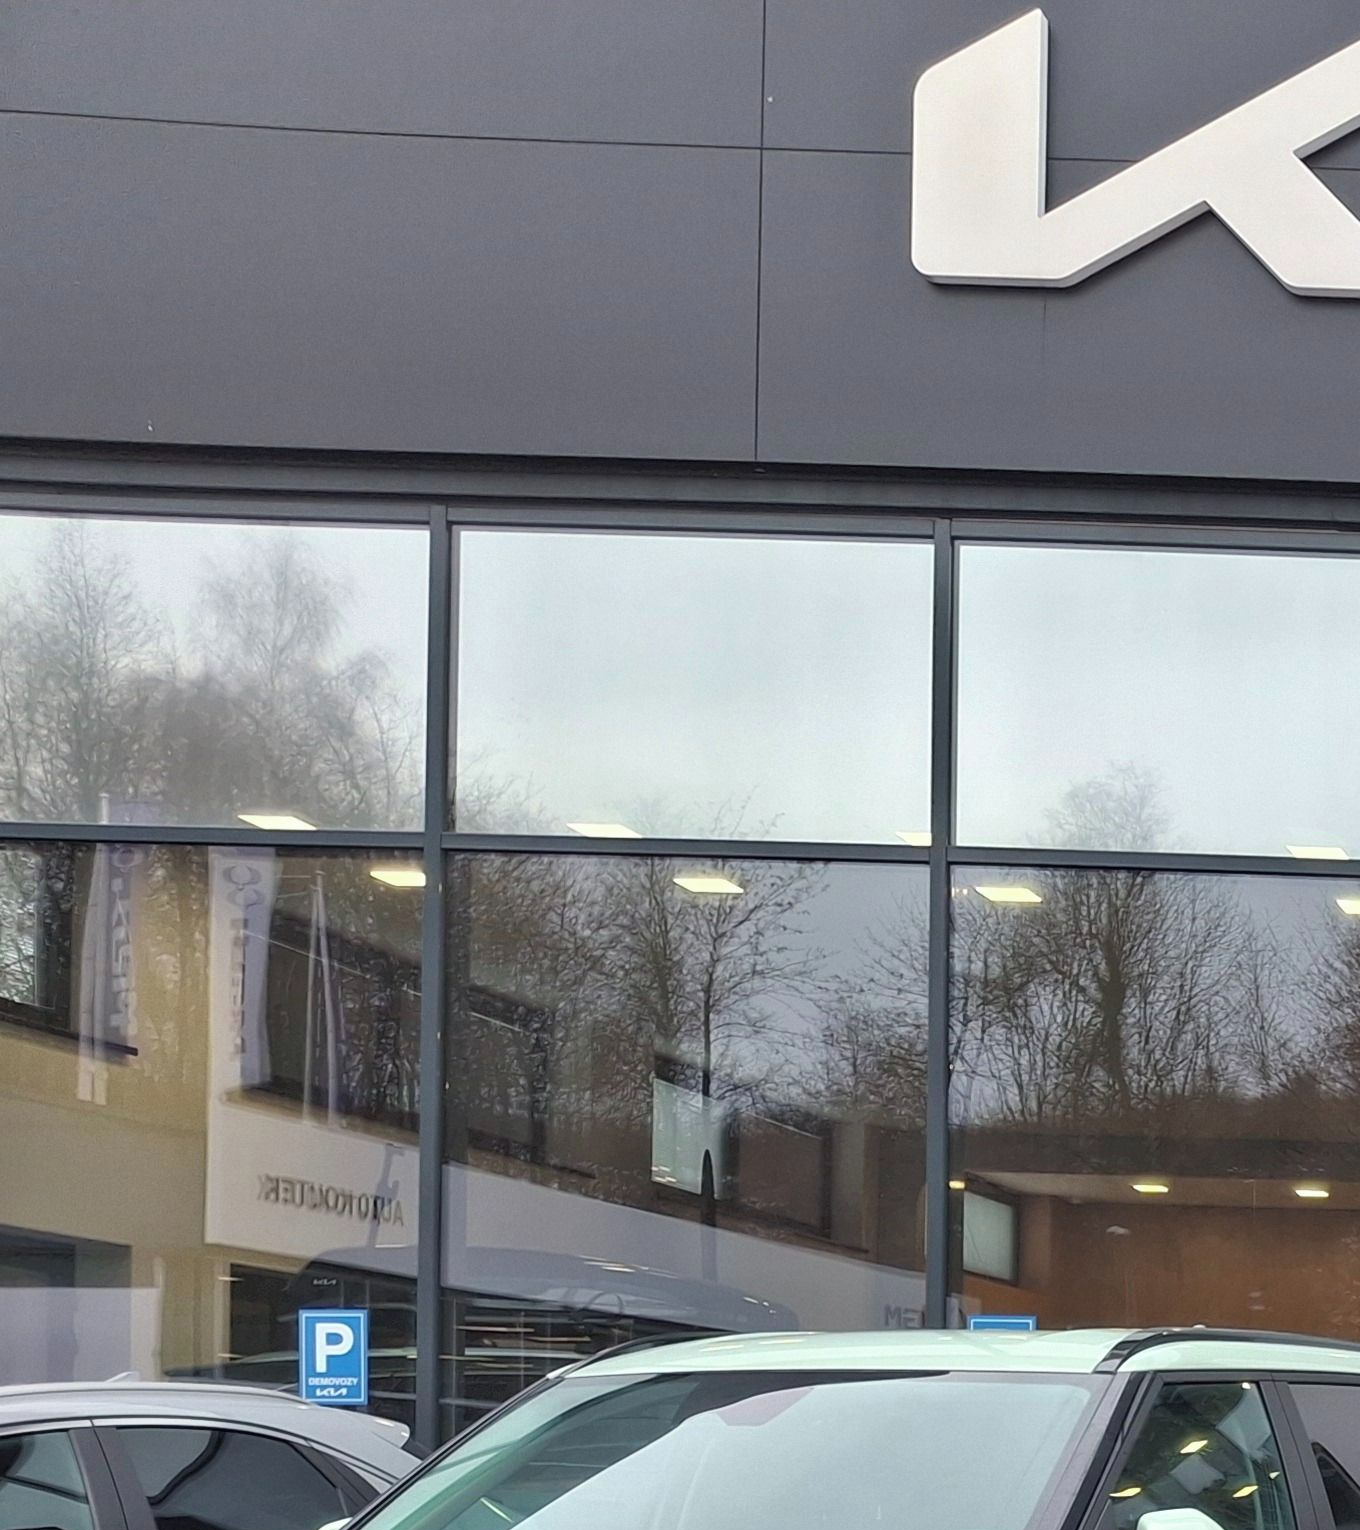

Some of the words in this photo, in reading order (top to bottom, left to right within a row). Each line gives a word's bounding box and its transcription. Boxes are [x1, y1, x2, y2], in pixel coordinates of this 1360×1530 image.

[315, 1322, 354, 1374] P
[308, 1377, 358, 1386] DEMOVOZY
[316, 1388, 348, 1397] KIA
